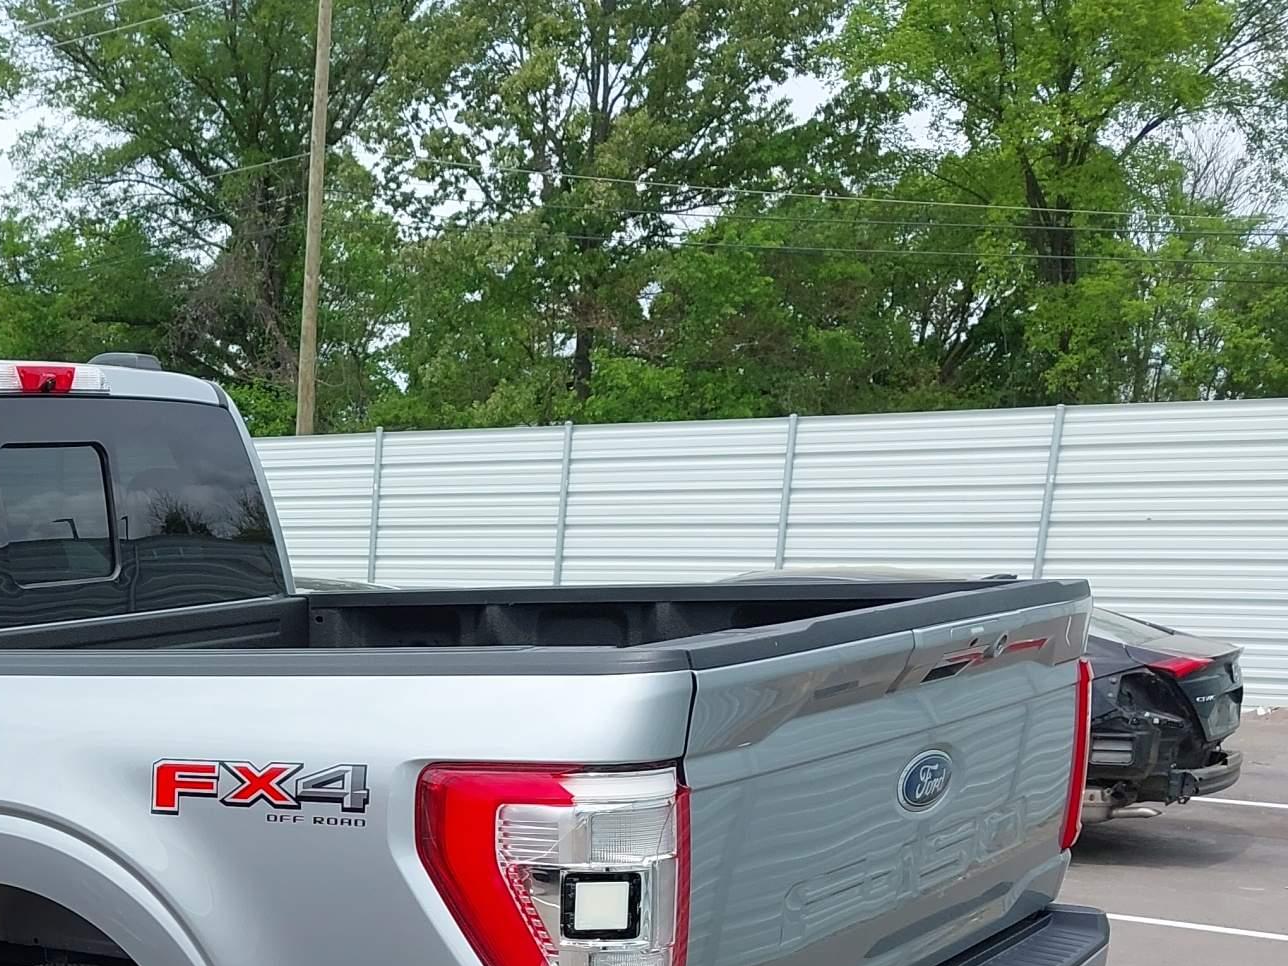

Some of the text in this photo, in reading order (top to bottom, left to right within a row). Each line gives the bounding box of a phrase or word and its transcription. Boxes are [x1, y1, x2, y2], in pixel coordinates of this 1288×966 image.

[150, 757, 371, 817] FX4
[915, 762, 947, 800] Ford
[266, 813, 367, 828] OFF ROAD
